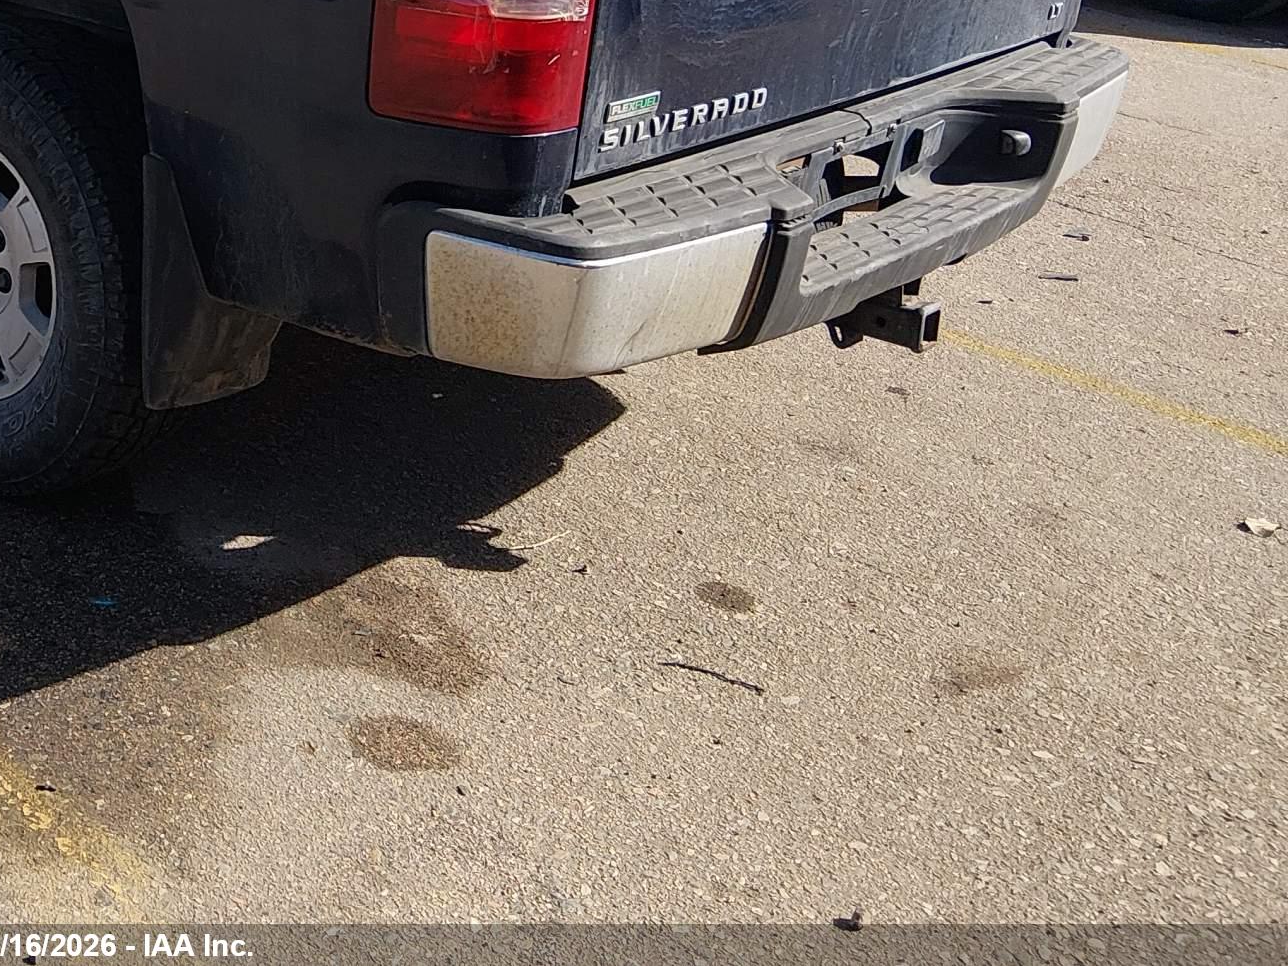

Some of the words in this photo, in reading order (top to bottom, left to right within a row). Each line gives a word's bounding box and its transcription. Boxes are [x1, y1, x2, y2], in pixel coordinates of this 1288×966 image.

[1049, 2, 1064, 19] LT
[612, 95, 660, 117] FLEXFUEL
[599, 87, 768, 152] SILVERADO
